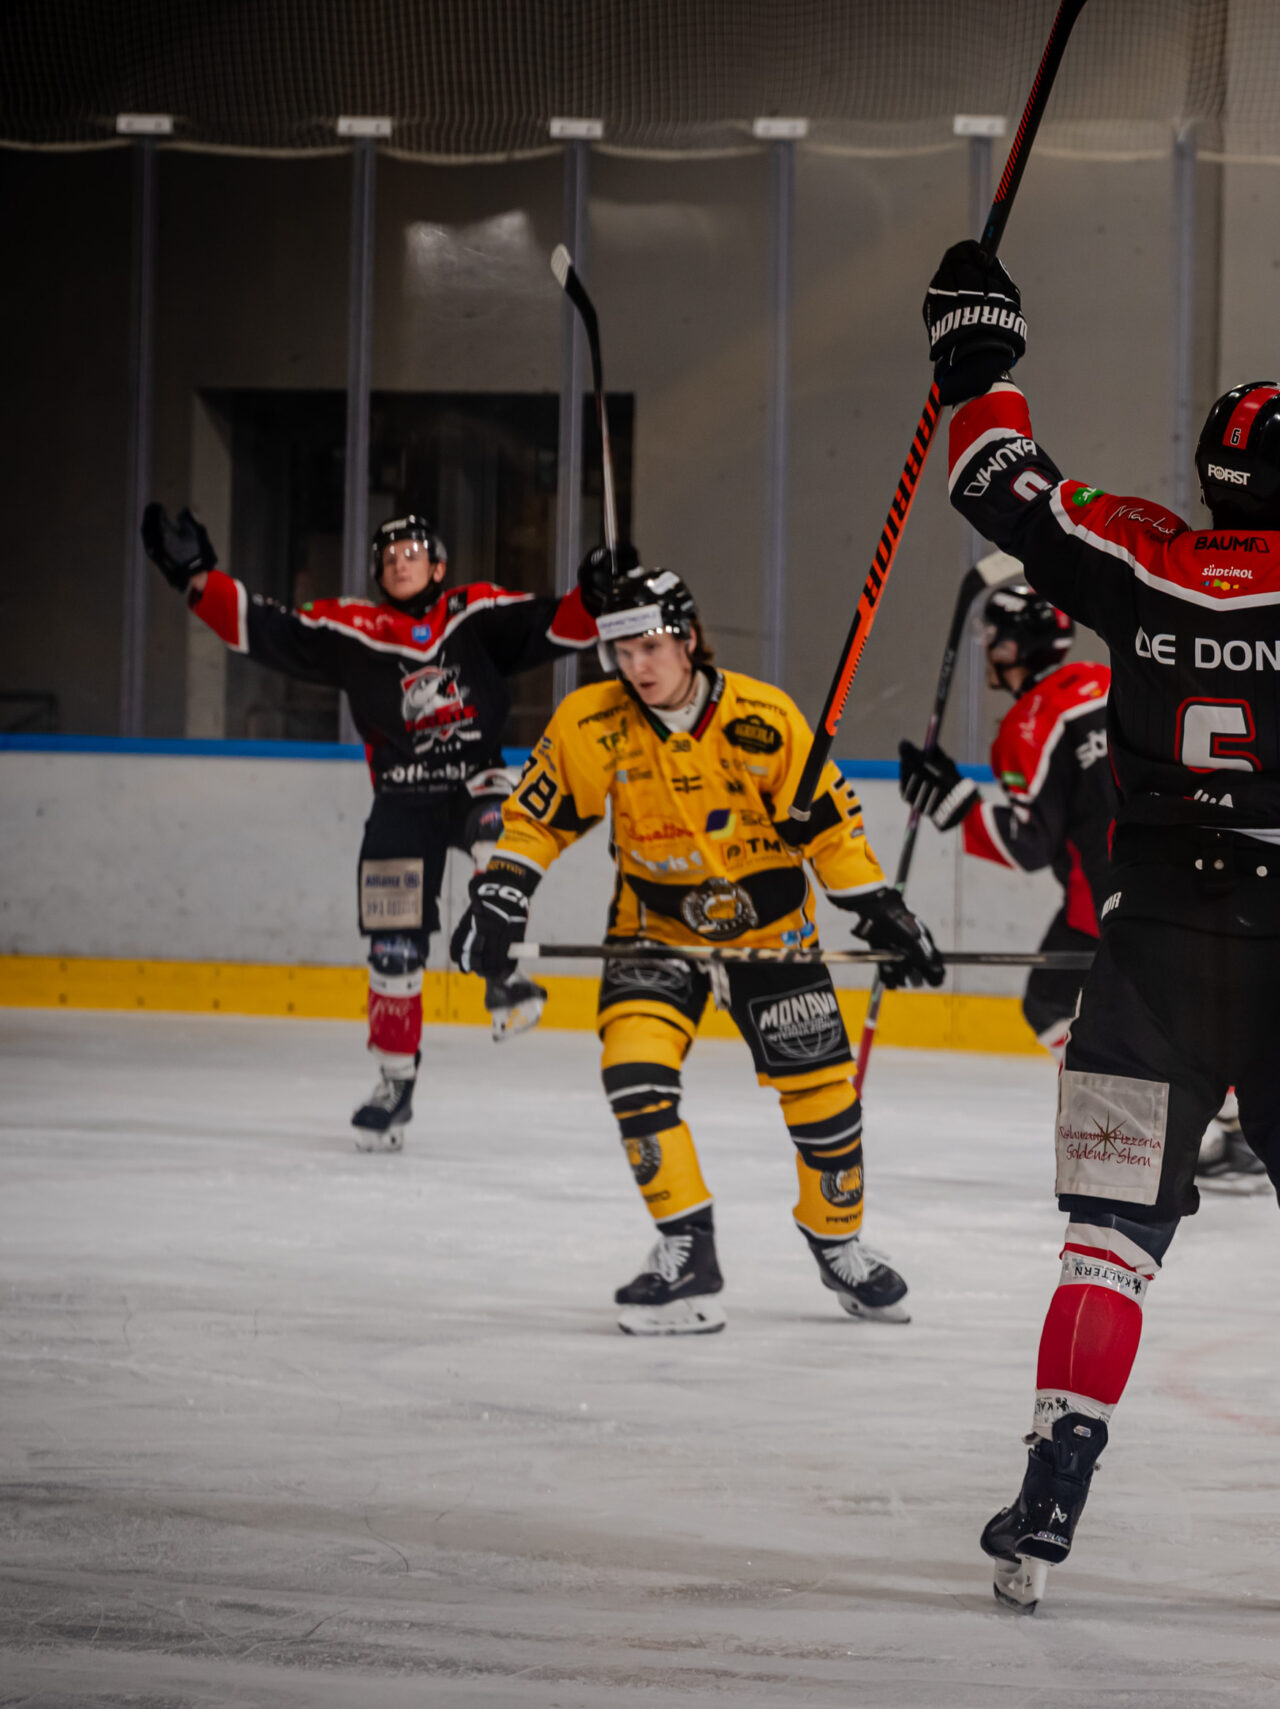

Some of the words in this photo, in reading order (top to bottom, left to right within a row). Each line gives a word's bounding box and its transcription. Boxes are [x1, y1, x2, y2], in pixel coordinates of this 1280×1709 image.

[931, 305, 1028, 347] WARRIOR
[1230, 427, 1241, 445] 6
[1207, 463, 1251, 486] FORST
[1113, 1129, 1162, 1150] Pizzeria
[1116, 1147, 1151, 1168] Stern
[1074, 1266, 1132, 1288] KALTERN
